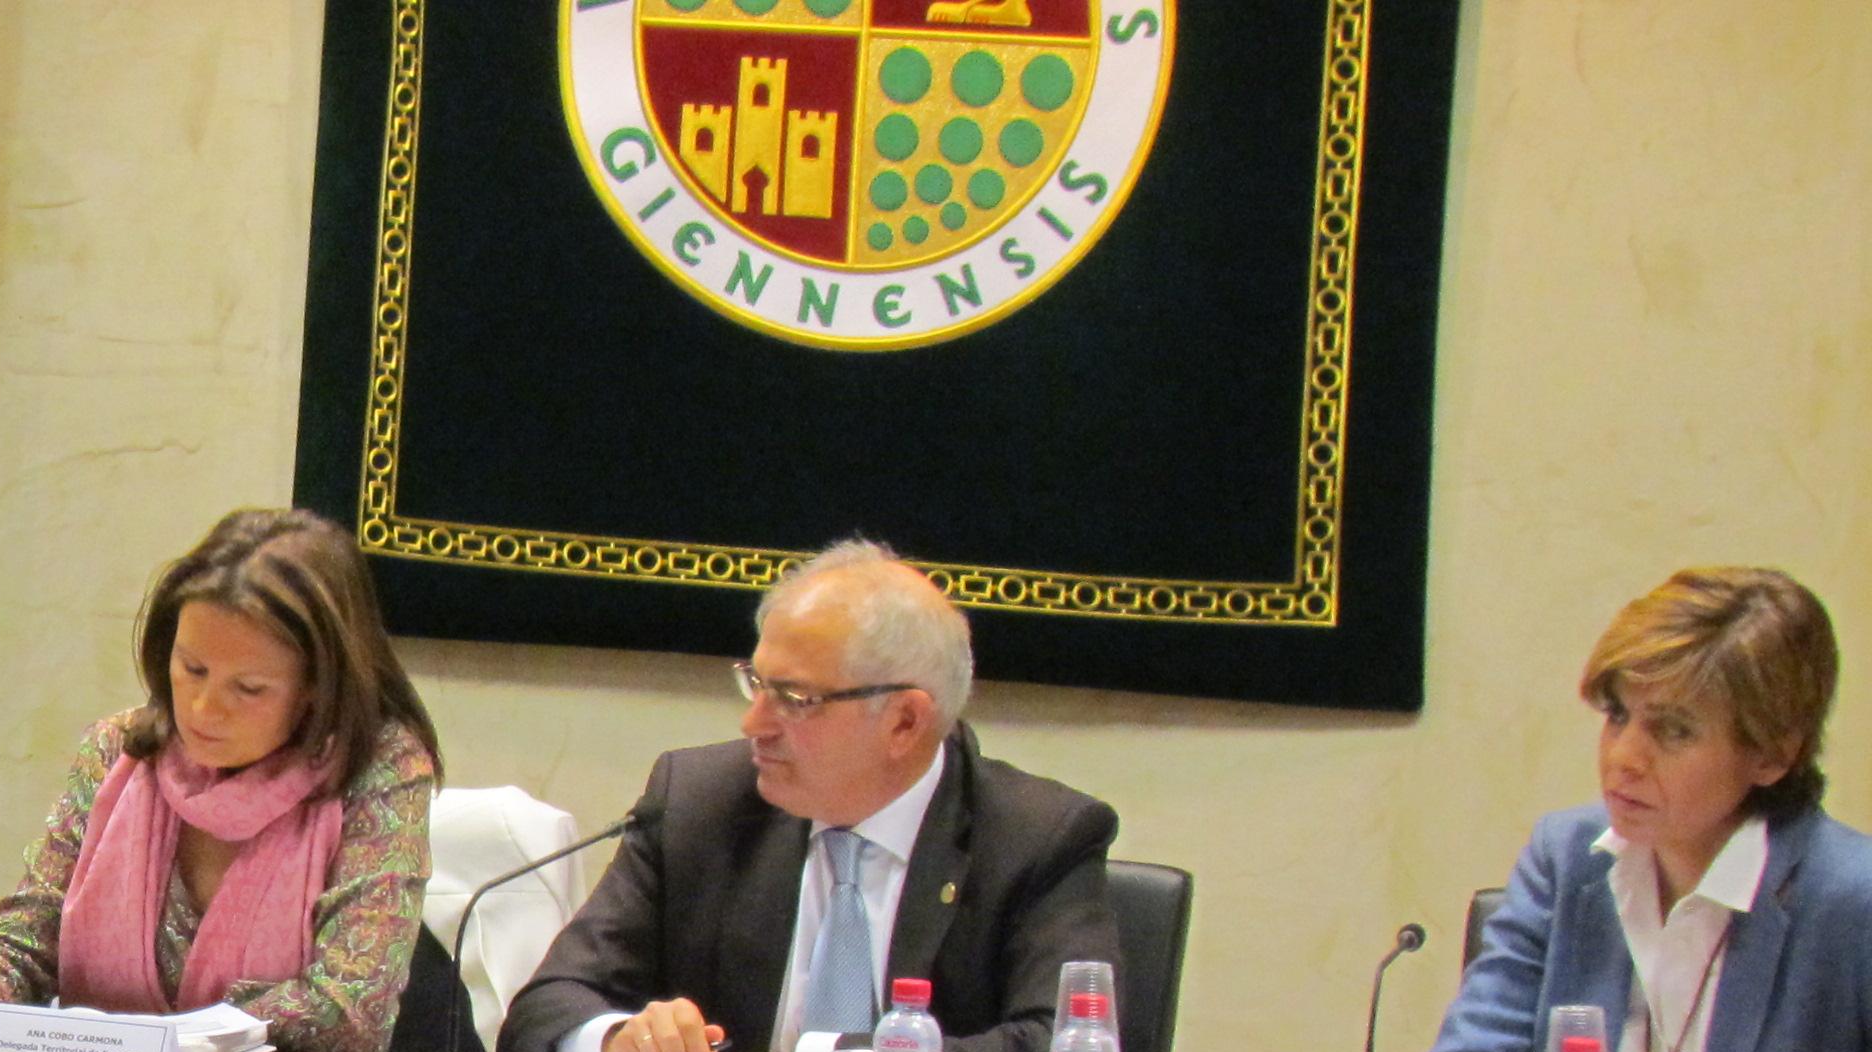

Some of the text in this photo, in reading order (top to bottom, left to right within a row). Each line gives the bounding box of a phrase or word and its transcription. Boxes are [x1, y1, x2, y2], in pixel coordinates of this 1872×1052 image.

[600, 126, 1108, 329] GIENNENSIS
[27, 1029, 124, 1047] ANA COBO CARMONA
